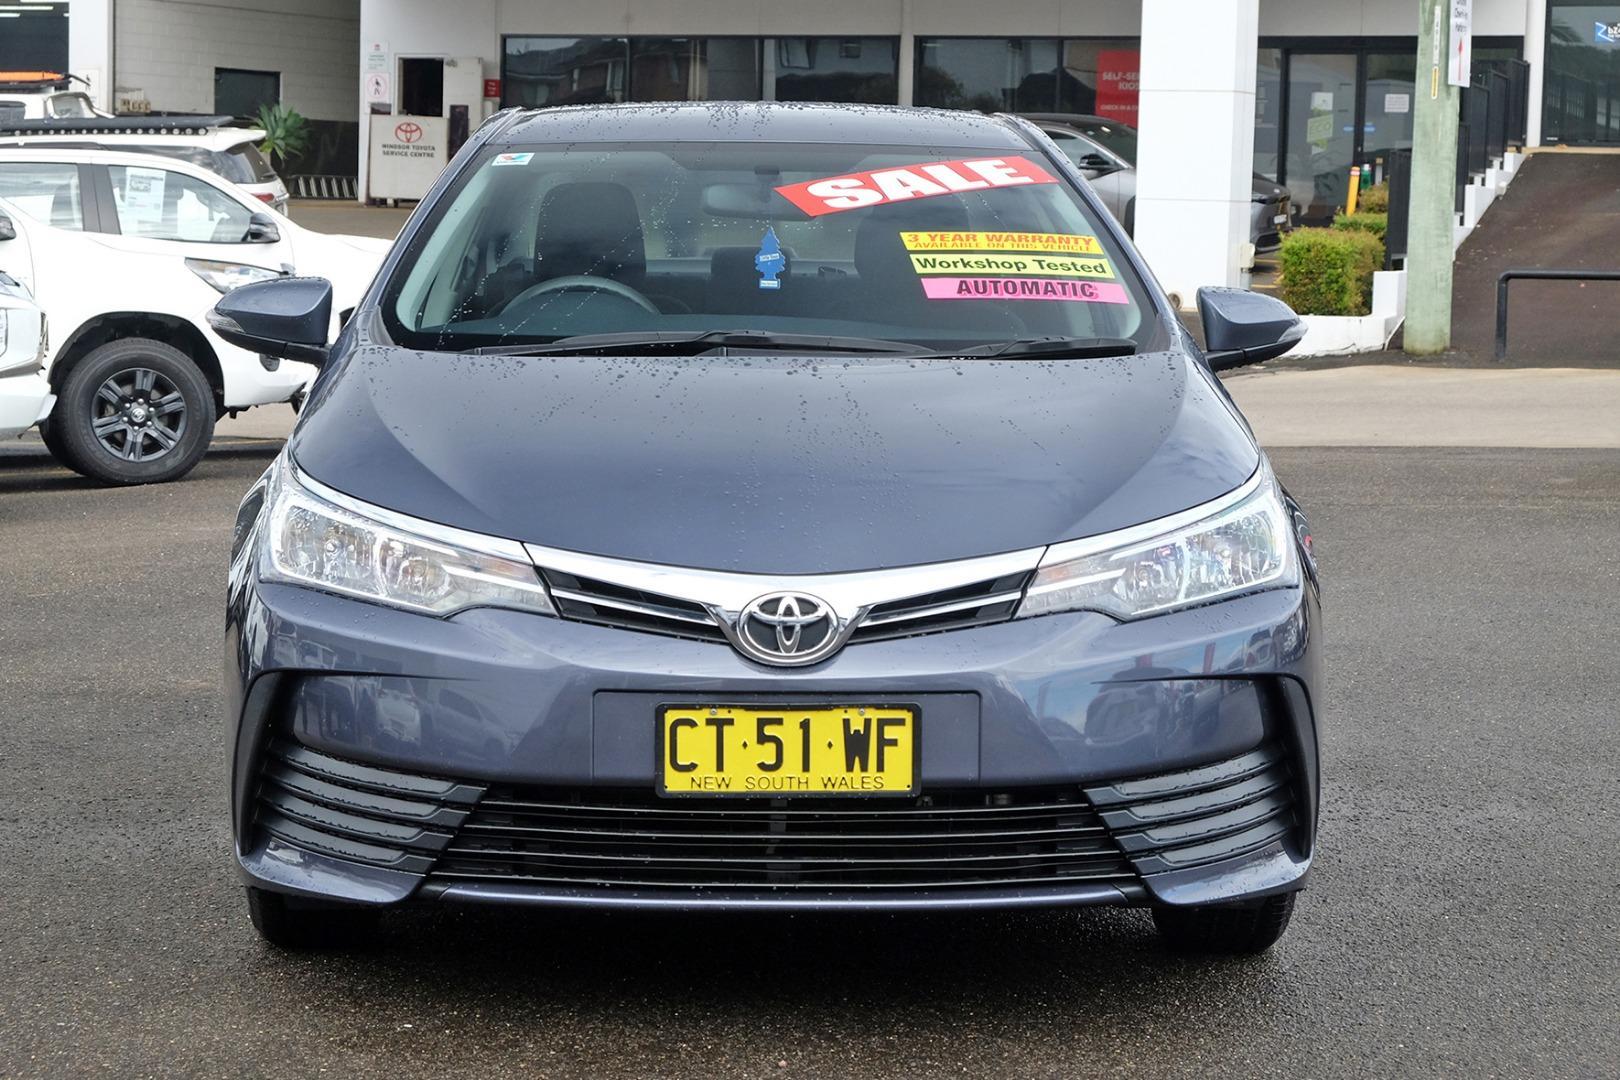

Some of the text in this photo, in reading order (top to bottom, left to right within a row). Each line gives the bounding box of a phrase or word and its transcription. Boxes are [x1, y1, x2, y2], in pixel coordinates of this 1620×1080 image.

[807, 160, 1033, 208] SALE
[908, 233, 1093, 246] 3 YEAR WARRANTY
[1011, 242, 1037, 250] THIS
[1042, 243, 1090, 252] VEHICLE
[915, 258, 1107, 274] Workshop Tested
[956, 280, 1097, 299] AUTOMATIC
[690, 776, 884, 790] NEW SOUTH WALES
